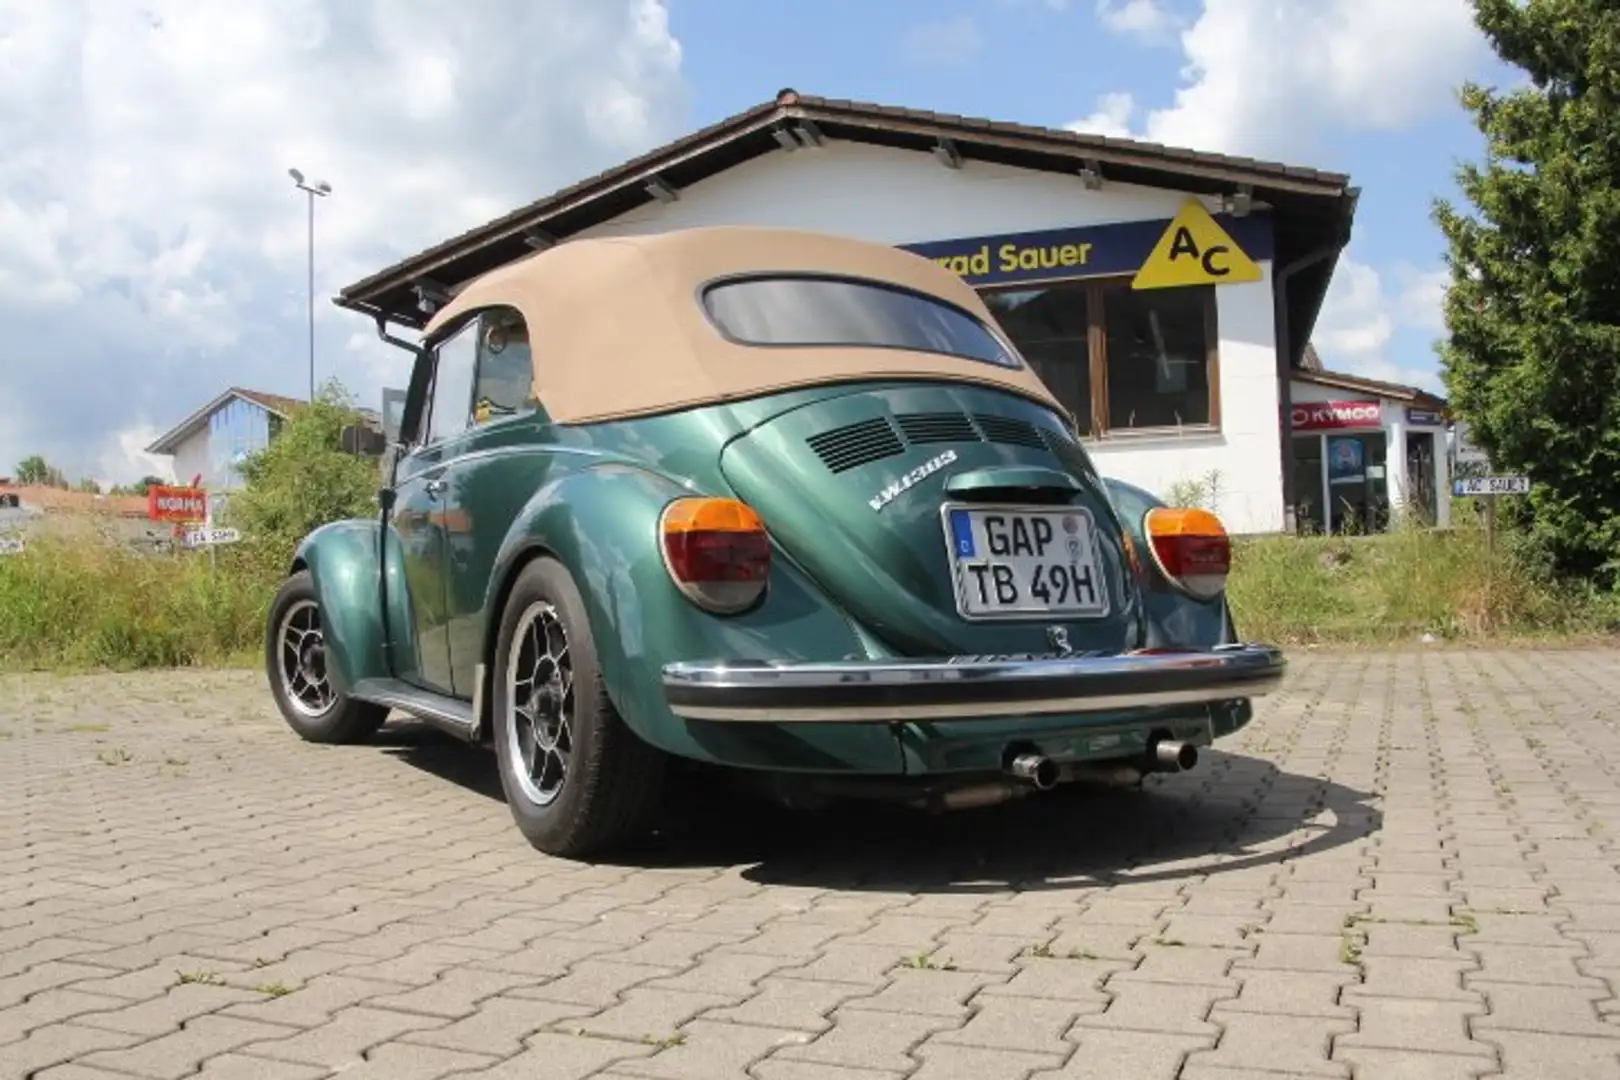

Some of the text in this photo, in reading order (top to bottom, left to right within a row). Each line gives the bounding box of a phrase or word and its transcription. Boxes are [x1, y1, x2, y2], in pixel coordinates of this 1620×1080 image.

[999, 243, 1092, 272] Sauer
[1312, 406, 1379, 421] KYMCO
[985, 515, 1053, 557] GAP
[968, 563, 1096, 604] TB 49H
